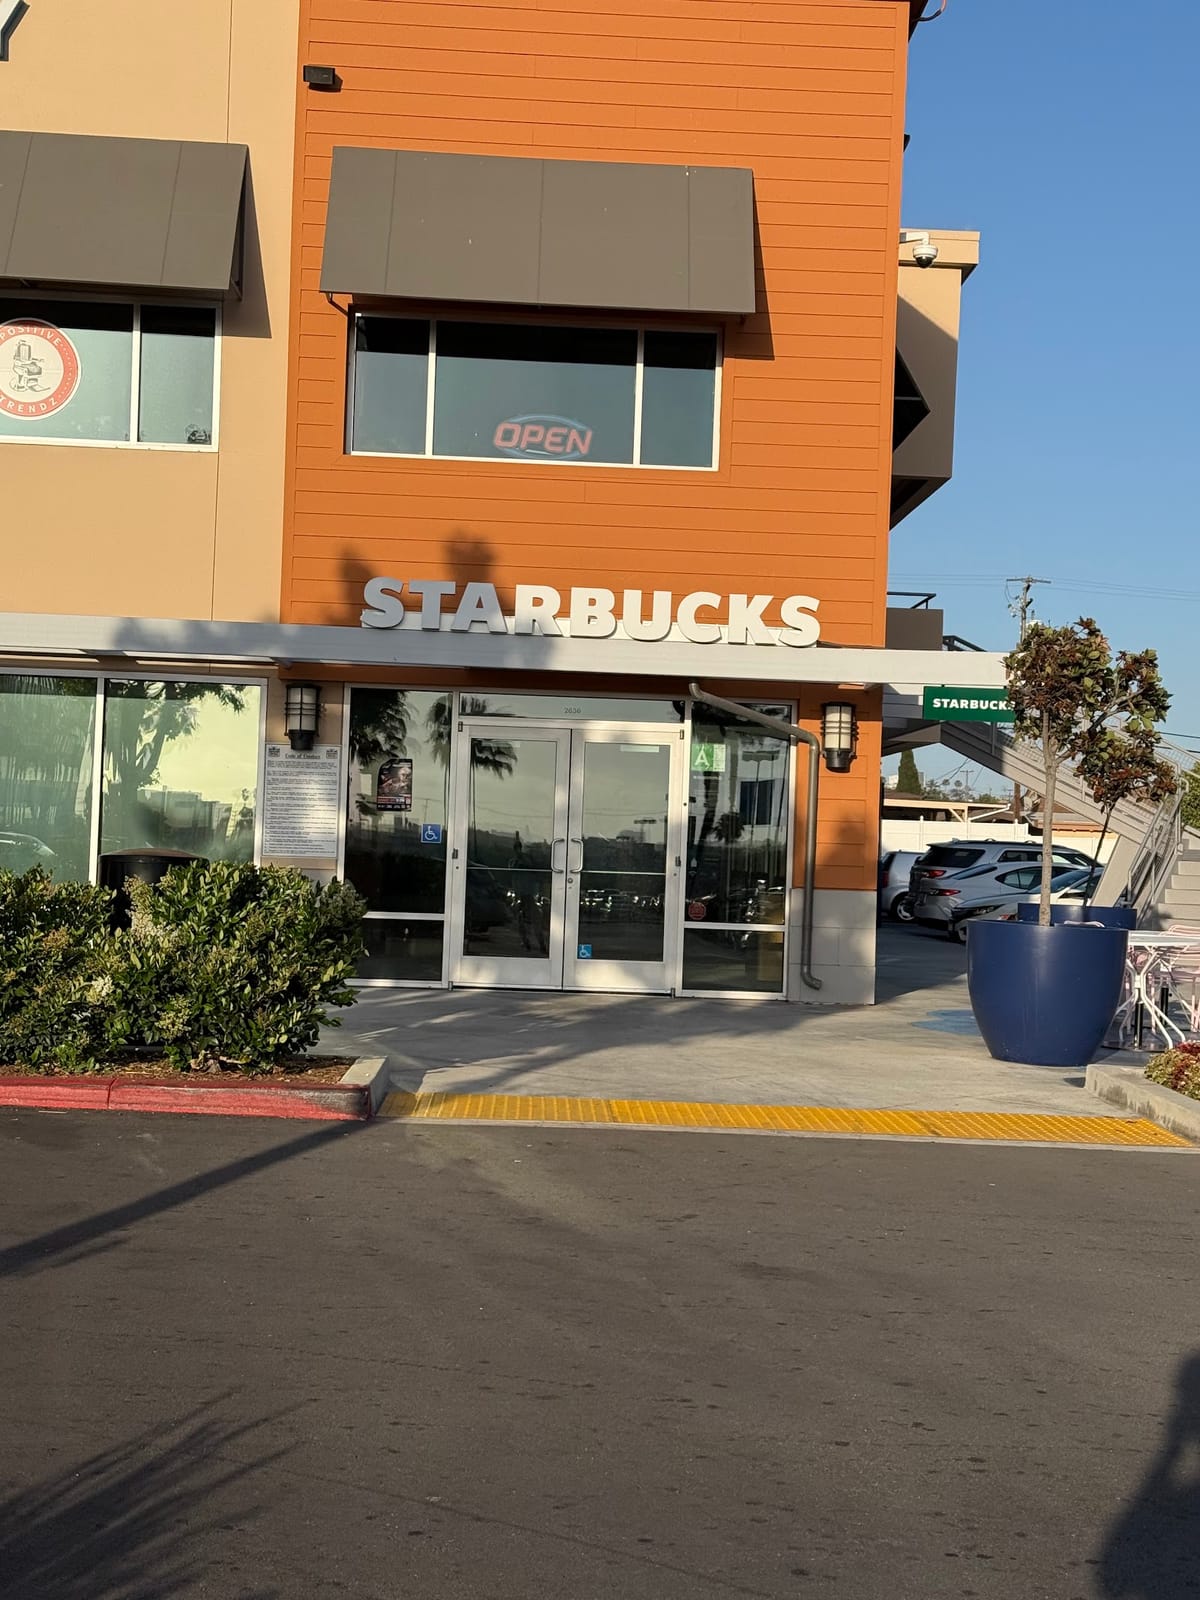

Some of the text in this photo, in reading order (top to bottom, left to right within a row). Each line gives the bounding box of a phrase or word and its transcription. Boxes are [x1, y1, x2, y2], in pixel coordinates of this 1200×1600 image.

[0, 326, 60, 346] POSITIVE
[494, 422, 592, 455] OPEN
[362, 577, 821, 648] STARBUCKS
[694, 747, 710, 766] A
